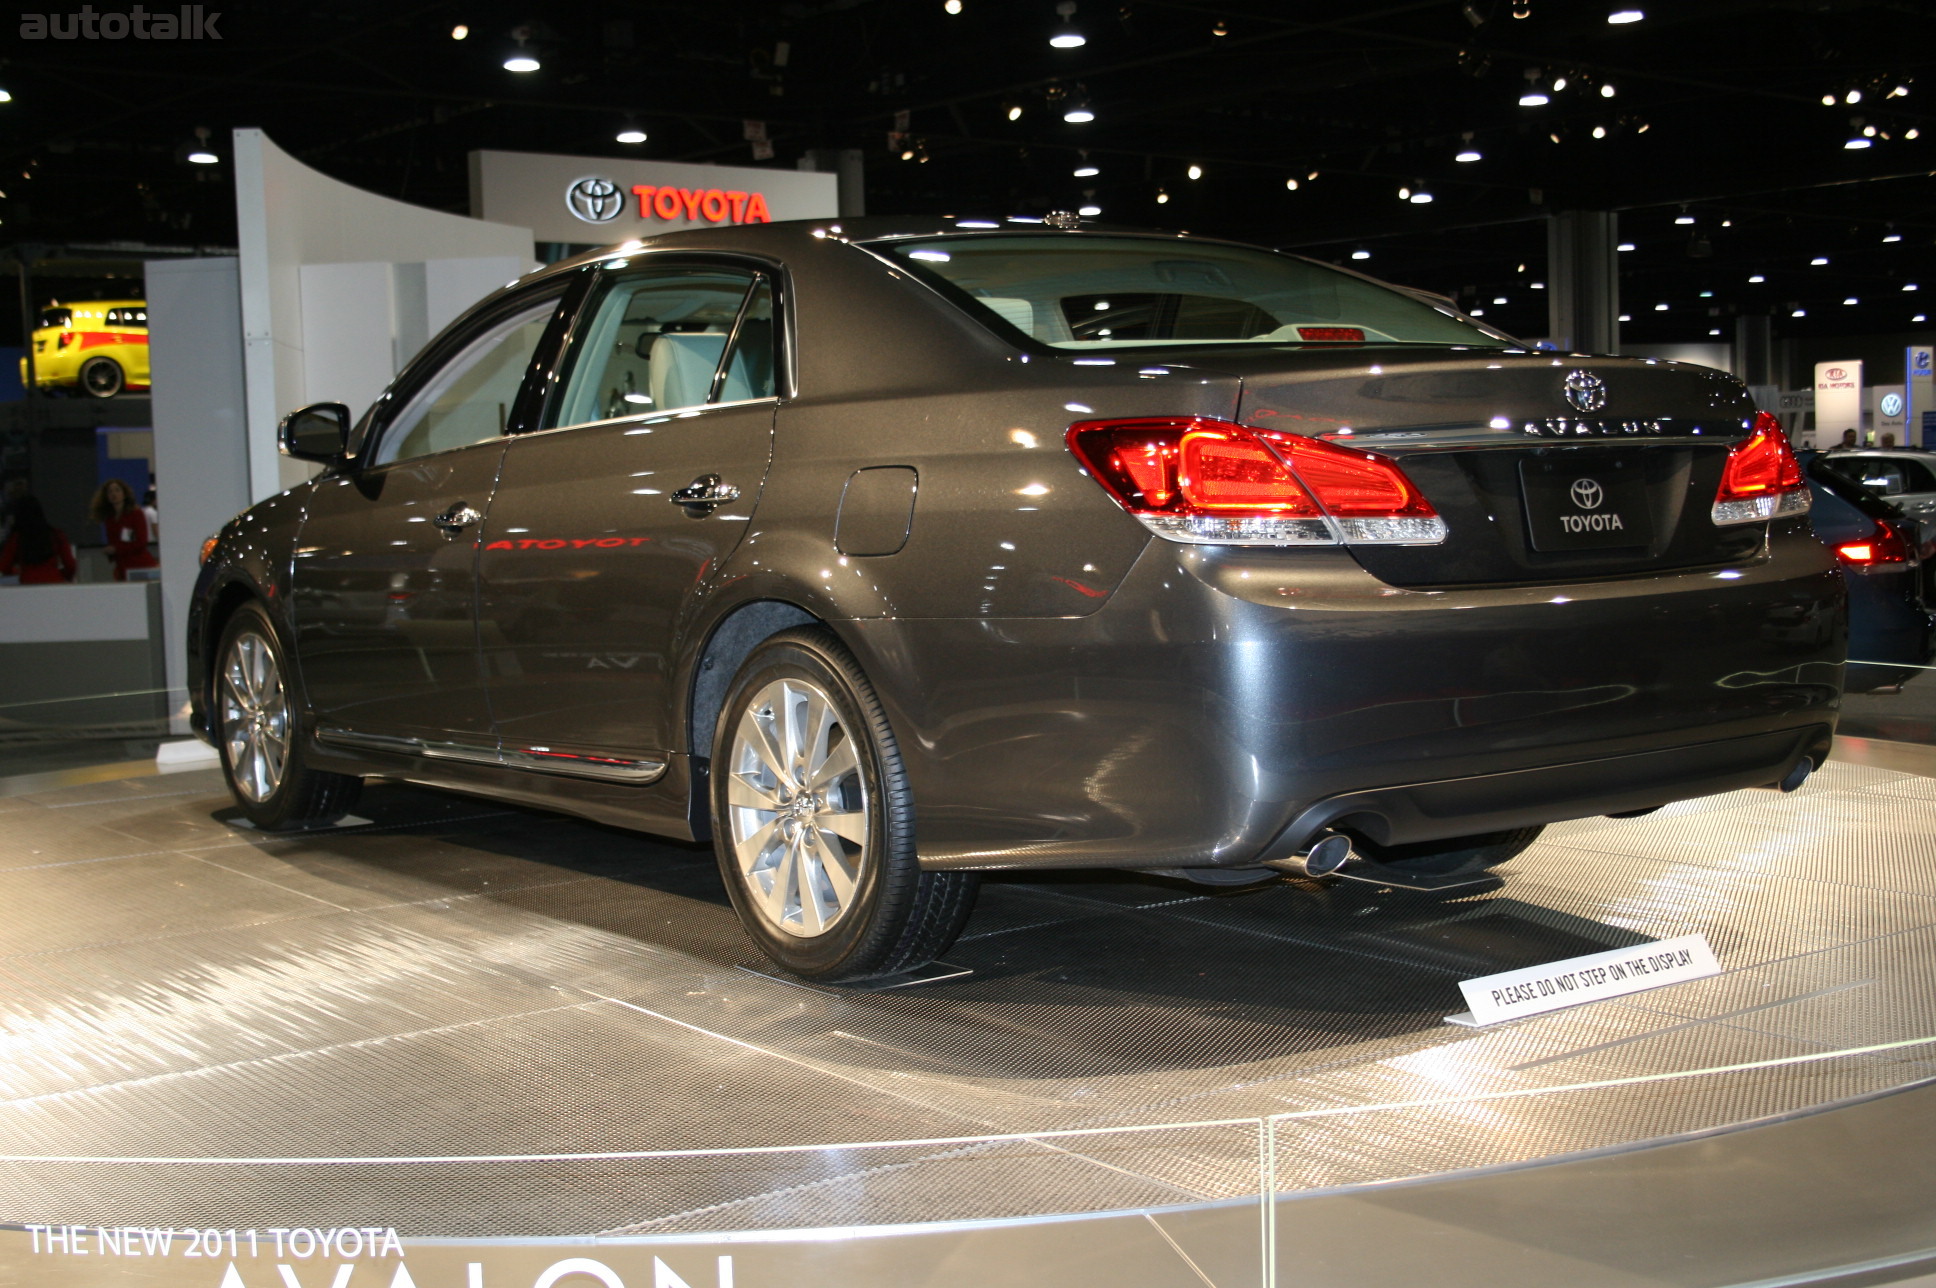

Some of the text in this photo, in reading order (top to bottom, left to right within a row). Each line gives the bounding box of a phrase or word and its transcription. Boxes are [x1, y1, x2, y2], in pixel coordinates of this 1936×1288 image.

[632, 185, 771, 223] TOYOTA
[1560, 514, 1623, 533] TOYOTA
[1491, 948, 1694, 1007] PLEASE DO NOT STEP ON THE DISPLAY
[25, 1224, 405, 1258] THE NEW 2011 TOYOTA
